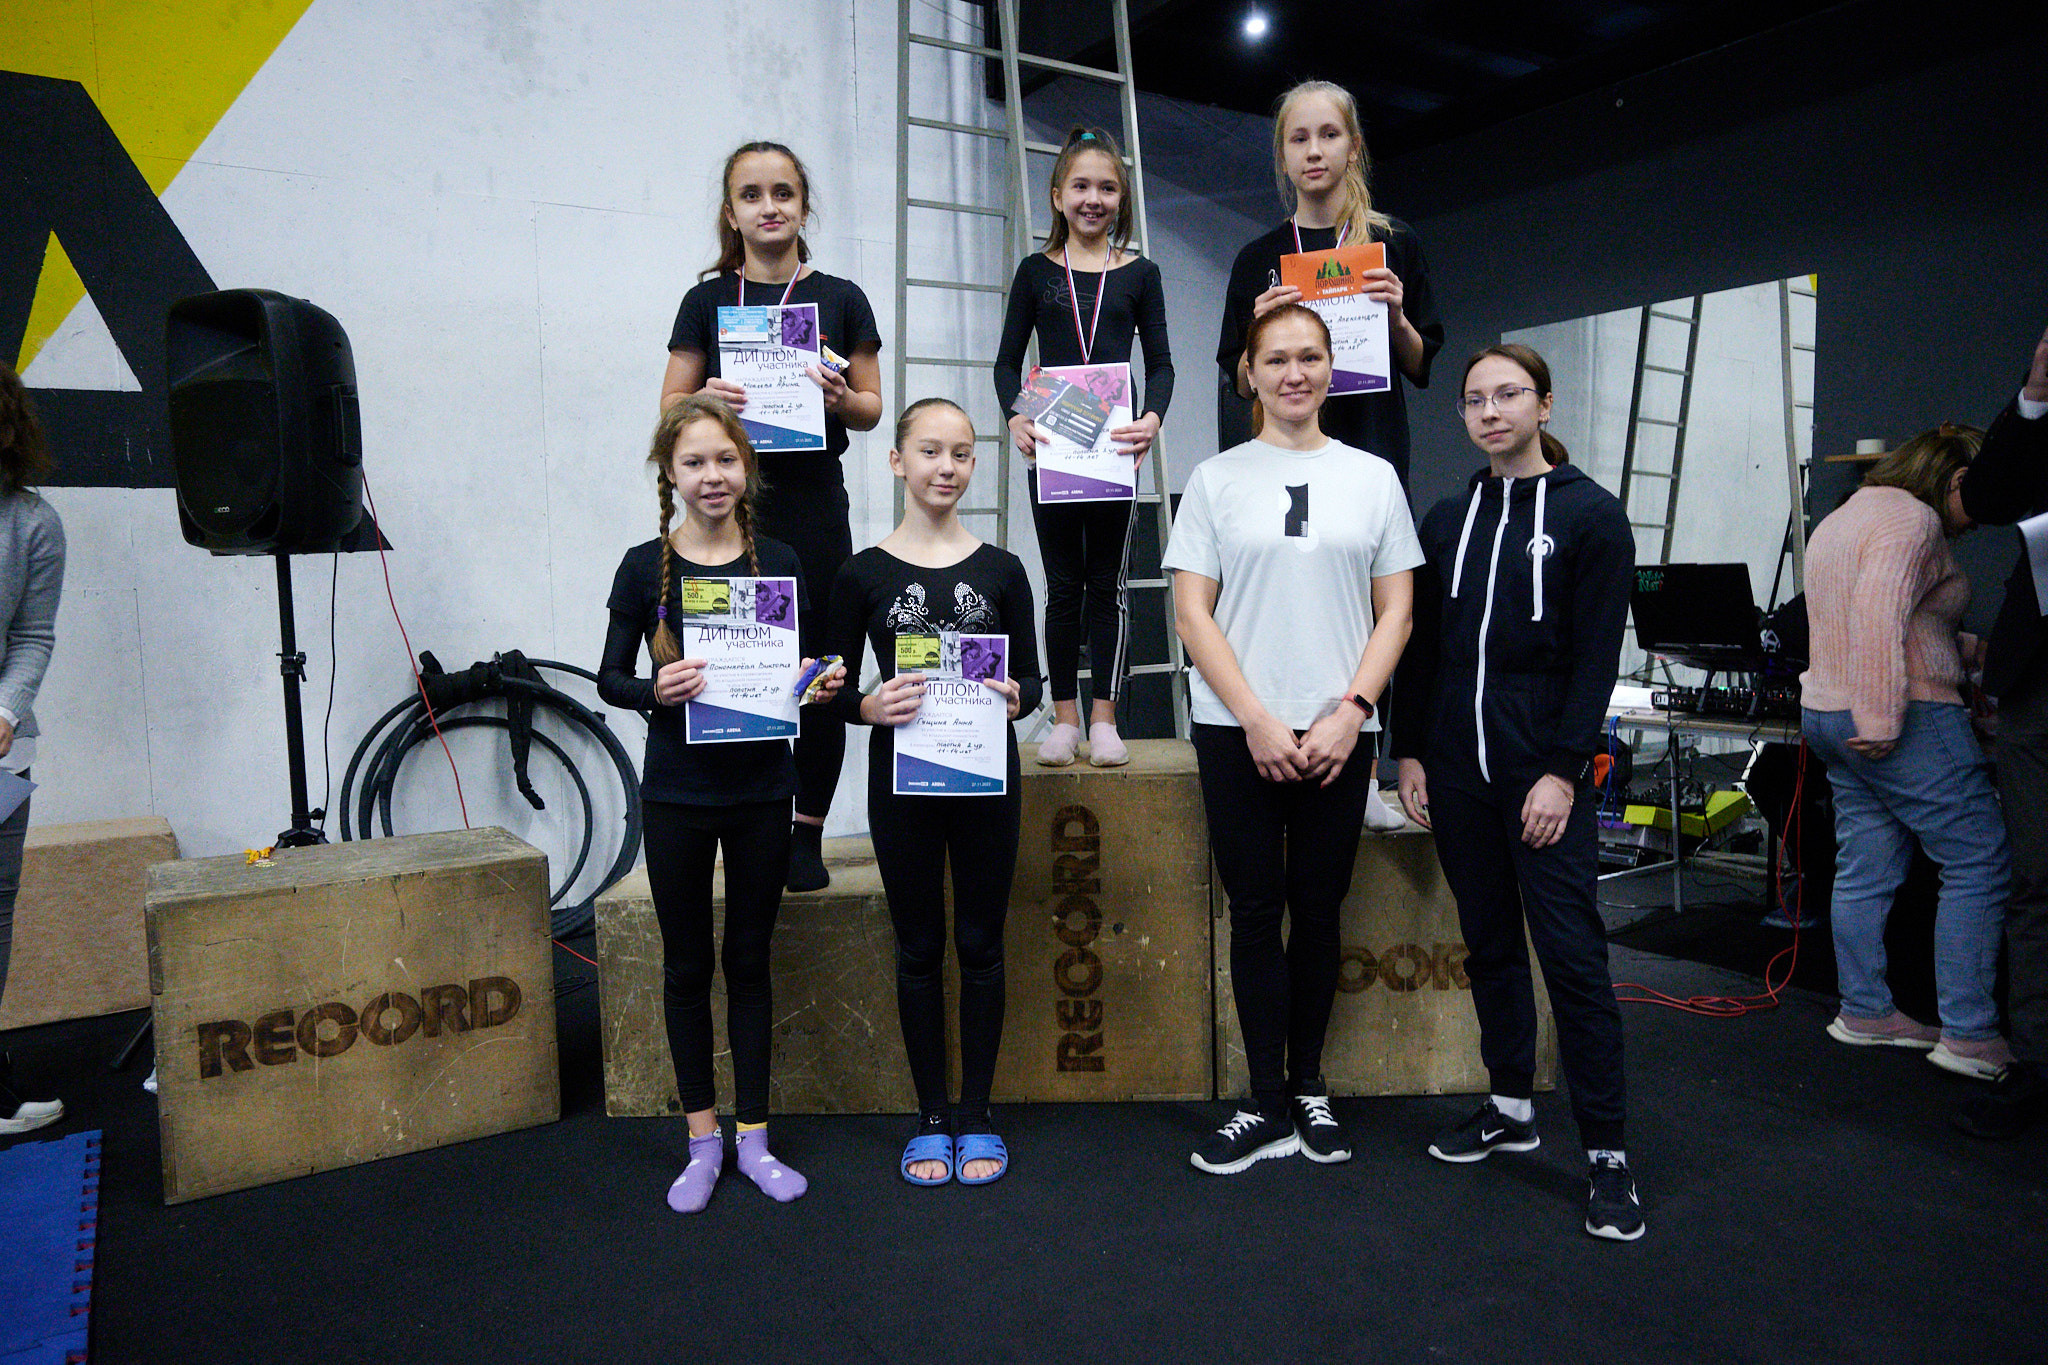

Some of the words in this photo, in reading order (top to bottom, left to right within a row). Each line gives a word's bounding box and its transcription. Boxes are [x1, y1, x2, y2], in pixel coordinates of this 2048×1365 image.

[1315, 276, 1355, 289] ПОРОШИНО
[1321, 286, 1348, 295] ТАЙПАРК
[1303, 295, 1356, 309] РАМОТА
[734, 349, 798, 365] ДИПЛОМ
[757, 361, 809, 371] участника
[698, 626, 771, 644] ДИПЛОМ
[725, 640, 784, 651] участника
[934, 696, 992, 707] участника
[952, 718, 974, 726] Анна
[1051, 803, 1105, 1072] RECORD
[1337, 943, 1472, 994] COR
[198, 976, 522, 1079] RECORD
